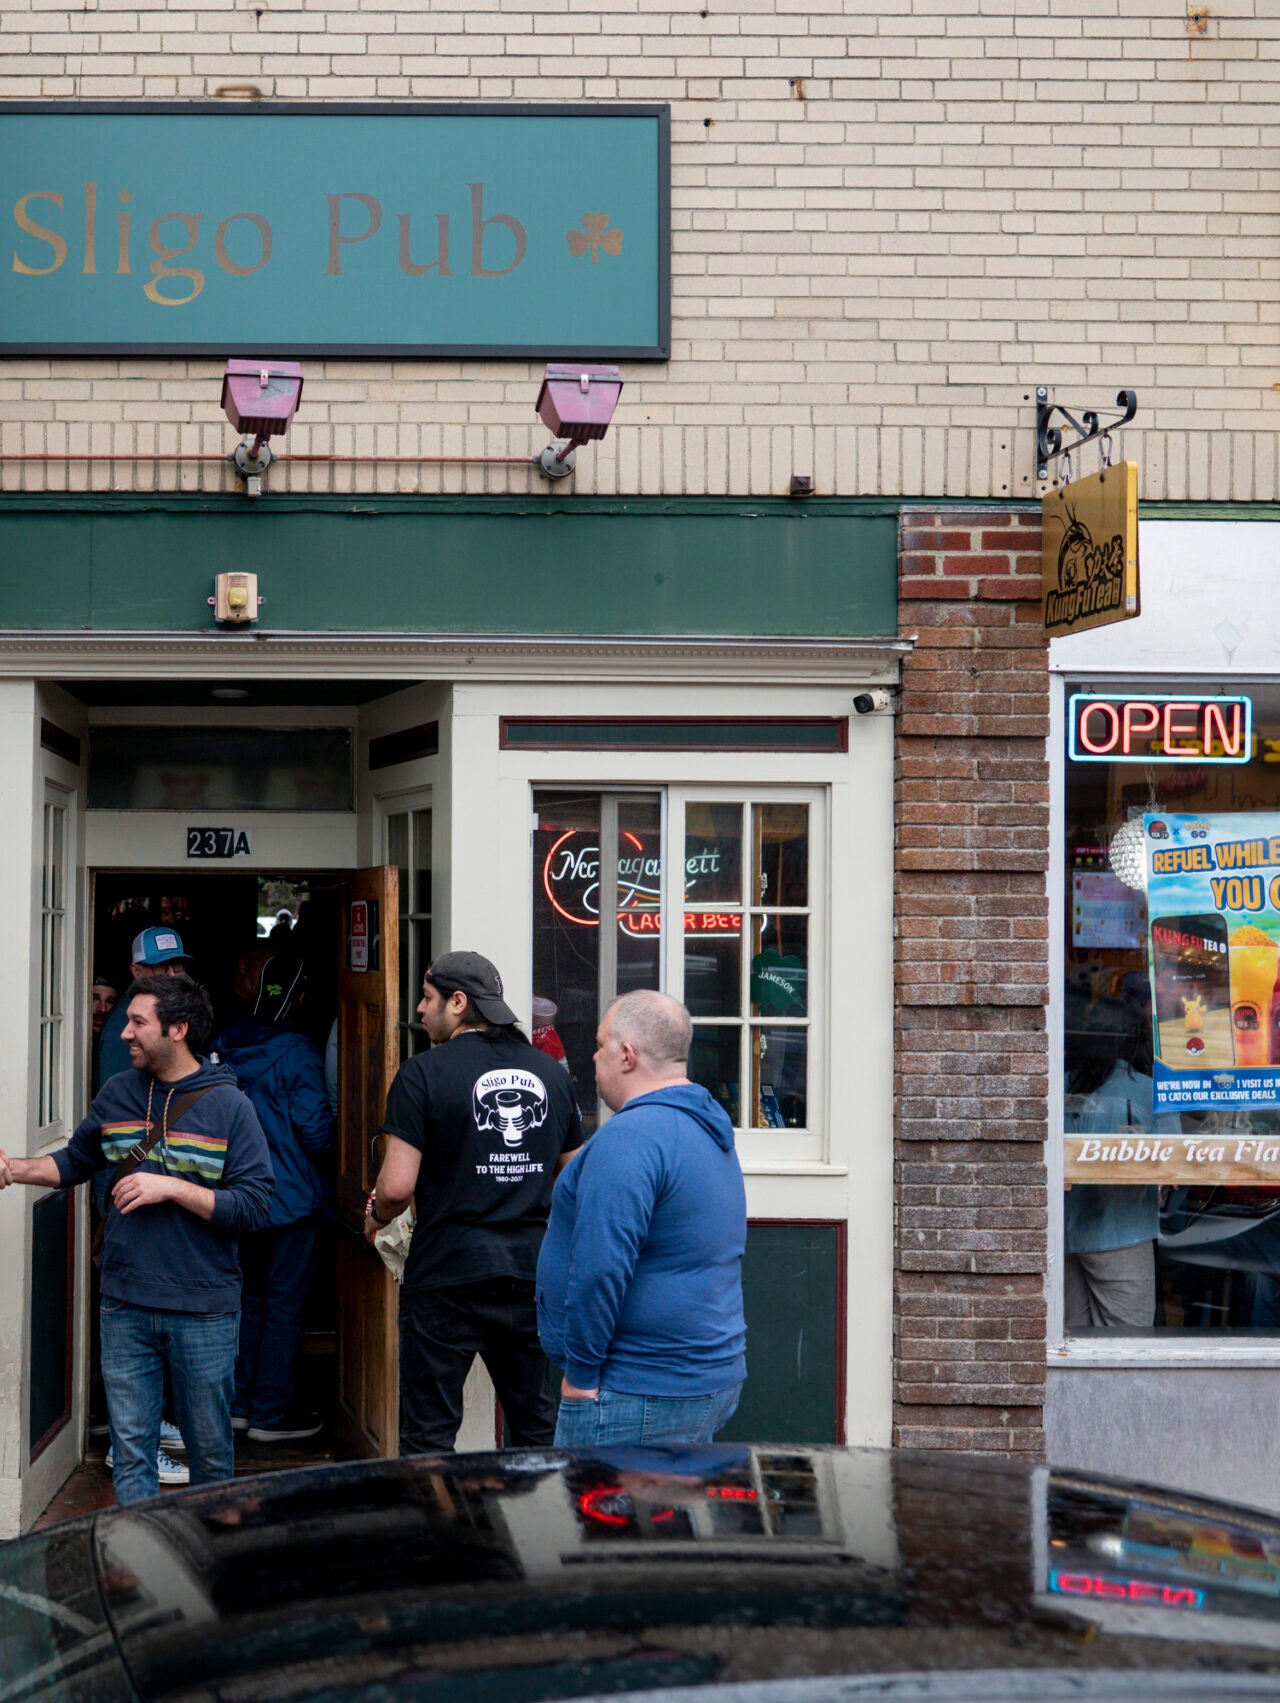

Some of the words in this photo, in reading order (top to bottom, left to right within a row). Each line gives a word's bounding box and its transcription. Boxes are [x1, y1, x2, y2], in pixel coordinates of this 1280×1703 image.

[12, 182, 273, 306] Sligo
[325, 183, 527, 277] Pub
[1080, 702, 1241, 755] OPEN
[189, 830, 251, 855] 237A
[1153, 846, 1213, 873] REFUEL
[1215, 838, 1280, 869] WHILE
[1211, 877, 1262, 910] YOU
[1153, 926, 1189, 947] KUNG
[1191, 936, 1203, 950] FU
[1203, 938, 1218, 953] TEA
[758, 971, 796, 994] JAMESON
[481, 1076, 506, 1090] Sligo
[511, 1075, 535, 1088] Pub
[1157, 1080, 1180, 1090] WE'RE
[1182, 1080, 1200, 1089] NOW
[1203, 1080, 1211, 1089] IN
[1242, 1079, 1261, 1088] VISIT
[1263, 1078, 1273, 1087] US
[1157, 1093, 1167, 1102] TO
[1168, 1091, 1191, 1102] CATCH
[1193, 1091, 1209, 1100] OUR
[1211, 1090, 1250, 1100] EXCLUSIVE
[1252, 1090, 1276, 1099] DEALS
[489, 1153, 530, 1162] FAREWELL
[1076, 1140, 1174, 1162] Bubble
[1183, 1140, 1226, 1162] Tea
[476, 1165, 488, 1174] TO
[489, 1165, 505, 1174] THE
[507, 1164, 525, 1174] HIGH
[525, 1163, 544, 1173] LIFE
